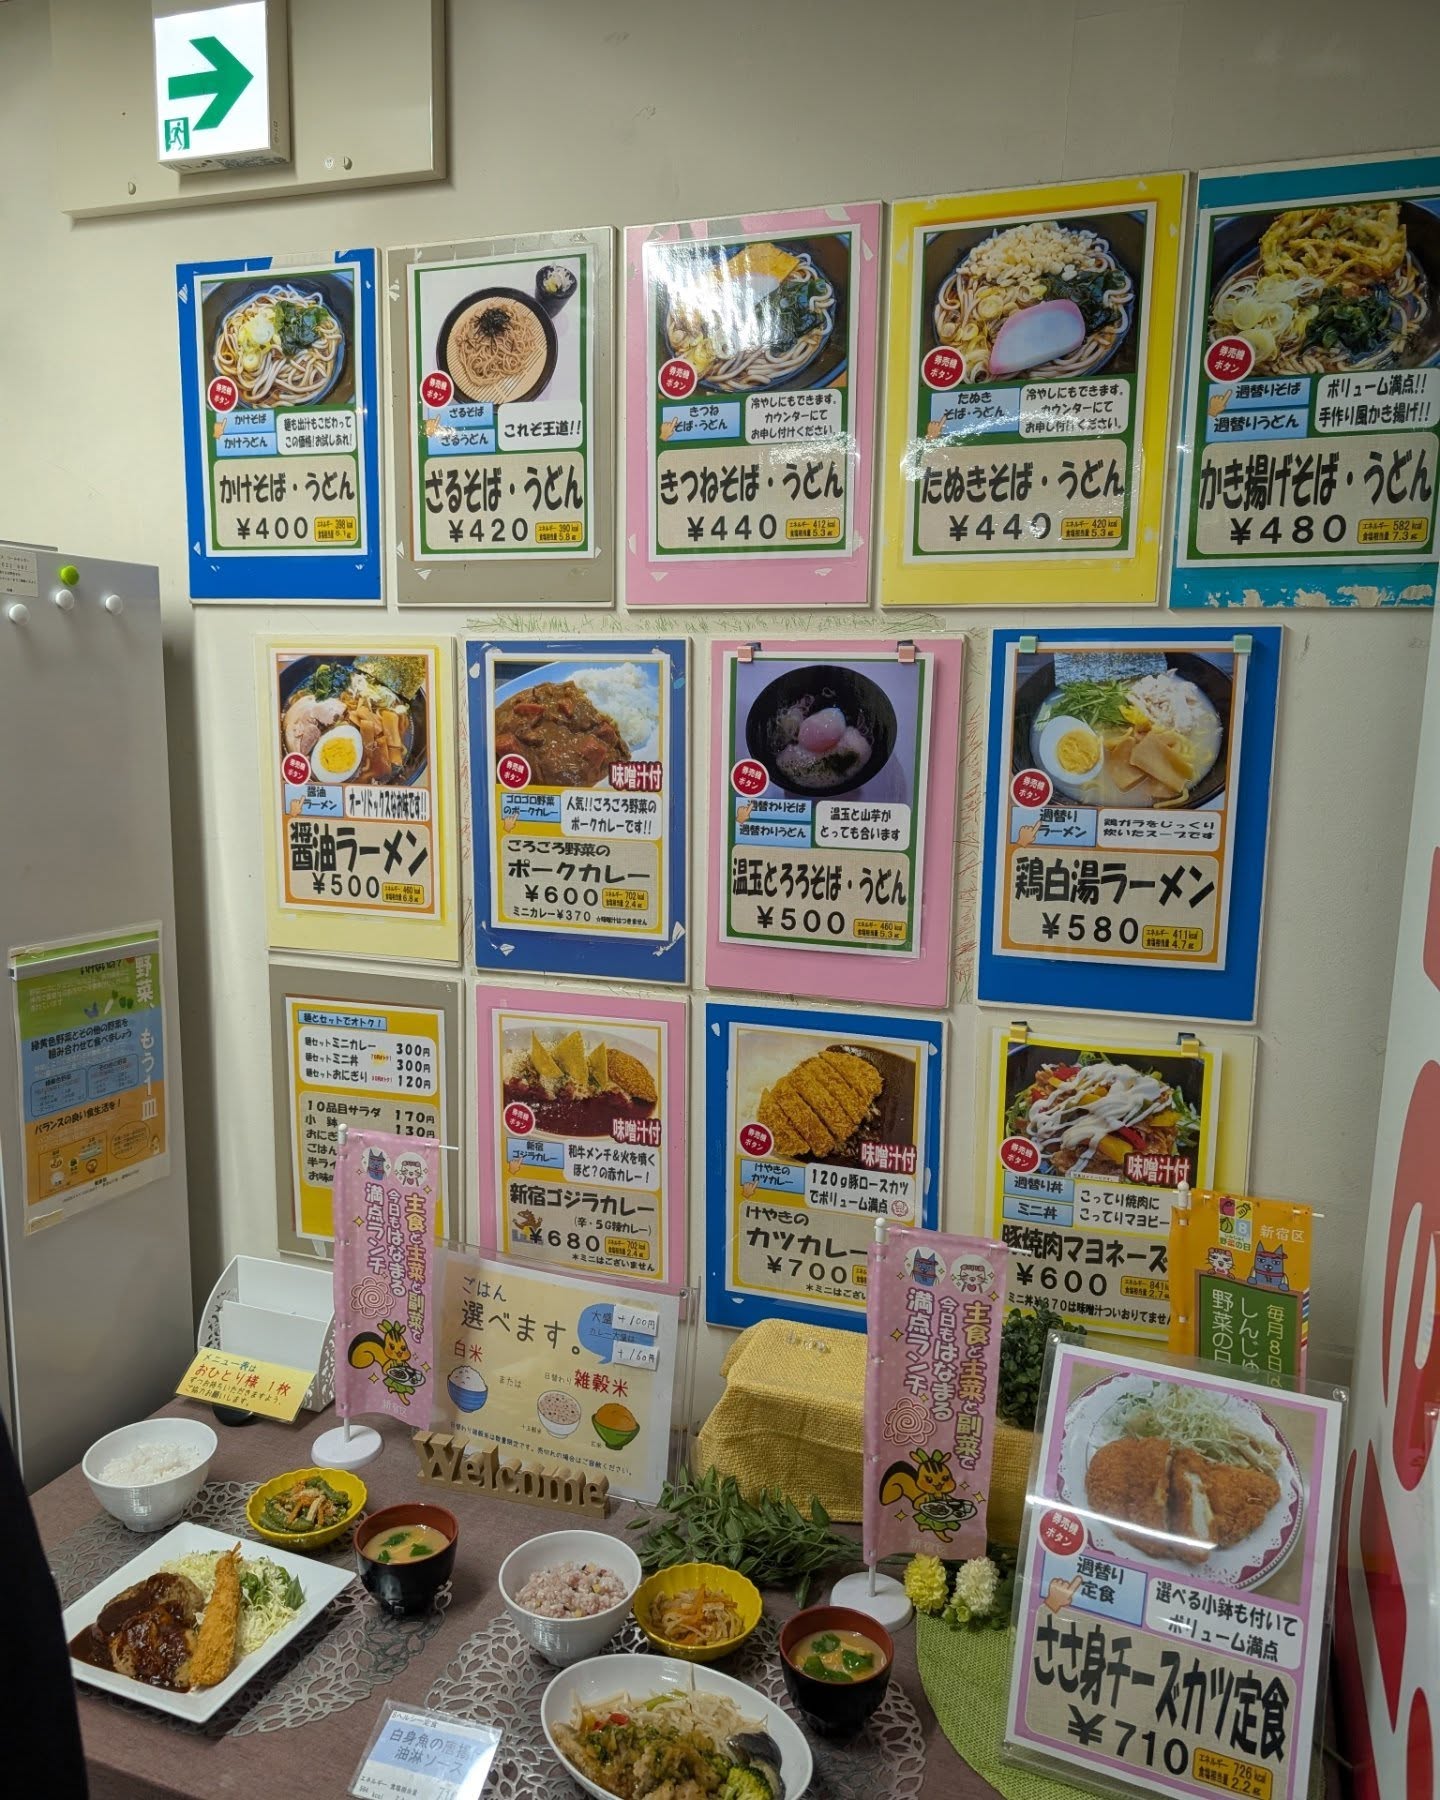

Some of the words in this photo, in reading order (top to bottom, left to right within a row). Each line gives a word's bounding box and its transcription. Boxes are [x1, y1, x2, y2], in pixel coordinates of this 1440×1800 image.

[933, 354, 958, 370] 券売機
[1218, 344, 1245, 361] 券売機
[668, 365, 690, 380] 券売機
[929, 367, 954, 381] ボタン
[1213, 360, 1240, 374] ボタン
[665, 378, 687, 391] ボタン
[1025, 383, 1124, 401] 冷やしにもできます。
[1235, 381, 1302, 400] 週替りそば
[1326, 373, 1428, 399] ボリューム満点!!
[426, 389, 445, 401] ボタン
[750, 393, 837, 410] 冷やしにもできます。
[957, 391, 993, 405] たぬき
[449, 406, 484, 419] ざるそば
[689, 404, 720, 418] きつね
[764, 409, 828, 424] カウンターにて
[943, 404, 1005, 422] そば・うどん
[1041, 400, 1114, 416] カウンターにて
[1318, 401, 1431, 428] 手作り風かき揚げ!!
[234, 413, 267, 426] かけそば
[504, 419, 582, 438] これぞ王道!!
[674, 418, 728, 433] そば・うどん
[1213, 414, 1300, 433] 週替りうどん
[440, 432, 489, 447] ざるうどん
[751, 424, 836, 441] お申し付けください。
[223, 436, 268, 449] かけうどん
[219, 471, 356, 504] かけそば・うどん
[425, 464, 584, 514] ざるそば・うどん
[660, 461, 844, 505] きつねそば・うどん
[921, 458, 1125, 505] たぬきそば・うどん
[1199, 449, 1433, 512] かき揚げそば・うどん
[236, 516, 309, 540] ¥400
[448, 517, 529, 543] ¥420
[686, 513, 778, 542] ¥440
[949, 512, 1052, 542] ¥440
[1230, 514, 1347, 546] ¥480
[1392, 520, 1411, 531] 582
[1391, 531, 1410, 542] 7.3
[504, 771, 522, 784] ボタン
[611, 763, 663, 790] 味噌汁付
[738, 776, 759, 790] ボタン
[1022, 776, 1046, 791] 券売機
[506, 794, 555, 806] ゴロゴロ野菜
[1018, 788, 1041, 801] ボタン
[303, 798, 337, 811] ラーメン
[503, 805, 559, 817] のポークカレー
[566, 796, 657, 814] 人気!!ごろごろ野菜の
[830, 806, 892, 823] 温玉と山芋が
[1039, 808, 1079, 823] 週替り
[571, 816, 653, 835] ポークカレーです!!
[739, 823, 807, 839] 週替わりうどん
[819, 825, 901, 841] とっても合います
[1037, 824, 1088, 838] ラーメン
[507, 839, 611, 857] ごろごろ野菜の
[507, 858, 650, 884] ポークカレー
[312, 871, 380, 899] ¥500
[732, 857, 907, 905] 温玉とろろそば・うどん
[1014, 856, 1215, 909] 鶏白湯ラーメン
[524, 884, 599, 907] ¥600
[756, 904, 846, 935] ¥500
[1041, 911, 1140, 945] ¥580
[1171, 929, 1187, 940] 411
[1171, 939, 1188, 950] 4.7
[396, 1042, 431, 1058] 300円
[396, 1058, 431, 1074] 300円
[398, 1074, 431, 1090] 120円
[34, 1098, 122, 1135] バランスの良い食生活を!
[307, 1099, 382, 1118] 10品目サラダ
[395, 1109, 436, 1125] 170円
[395, 1124, 436, 1139] 130円
[509, 1118, 527, 1130] ボタン
[612, 1117, 662, 1145] 味噌汁付
[306, 1143, 338, 1156] ごはん
[526, 1140, 544, 1152] 新宿
[744, 1137, 764, 1151] ボタン
[512, 1150, 559, 1163] ゴジラカレー
[860, 1142, 917, 1174] 味噌汁付
[1006, 1152, 1030, 1168] ボタン
[573, 1163, 650, 1184] ほど?の赤カレー!
[754, 1162, 791, 1176] けやきの
[751, 1172, 794, 1187] カツカレー
[811, 1168, 909, 1196] 120g豚ロースカツ
[1014, 1175, 1064, 1194] 週替り丼
[509, 1182, 655, 1217] 新宿ゴジラカレー
[809, 1190, 889, 1215] でボリューム満点
[1080, 1189, 1160, 1211] こってり焼肉に
[745, 1205, 810, 1227] けやきの
[1017, 1201, 1058, 1221] ミニ丼
[364, 1182, 386, 1276] 満点ランチ
[1238, 1222, 1248, 1235] 8
[1260, 1224, 1305, 1243] 新宿区
[386, 1189, 406, 1297] 今日もはなまる
[529, 1226, 600, 1253] ¥680
[746, 1226, 869, 1259] カツカレー
[1219, 1237, 1252, 1251] 野菜の日
[766, 1254, 848, 1285] ¥700
[1016, 1261, 1108, 1297] ¥600
[462, 1276, 508, 1303] ごはん
[460, 1299, 581, 1356] 選べます。
[453, 1339, 484, 1364] 白米
[902, 1287, 935, 1399] 満点ランチ
[931, 1295, 960, 1422] 今日もはなまる
[194, 1363, 260, 1389] おひとり様
[268, 1381, 292, 1397] 1枚
[498, 1374, 523, 1389] または
[573, 1368, 629, 1398] 雑穀米
[953, 1299, 993, 1471] 主食と主菜と副菜で
[412, 1430, 610, 1508] Welcome
[1050, 1511, 1079, 1536] 券売機
[1045, 1526, 1073, 1549] ボタン
[1076, 1555, 1125, 1585] 週替り
[1080, 1579, 1116, 1605] 定食
[1155, 1580, 1298, 1637] 選べる小鉢も付いて
[1168, 1613, 1279, 1663] ボリューム満点
[1034, 1613, 1290, 1763] ささ身チーズカツ定食
[1066, 1703, 1190, 1776] ¥710
[394, 1746, 464, 1777] 油淋ソース
[1199, 1752, 1229, 1770] エネルギー
[1233, 1761, 1253, 1780] 726
[1230, 1775, 1252, 1795] 2.2
